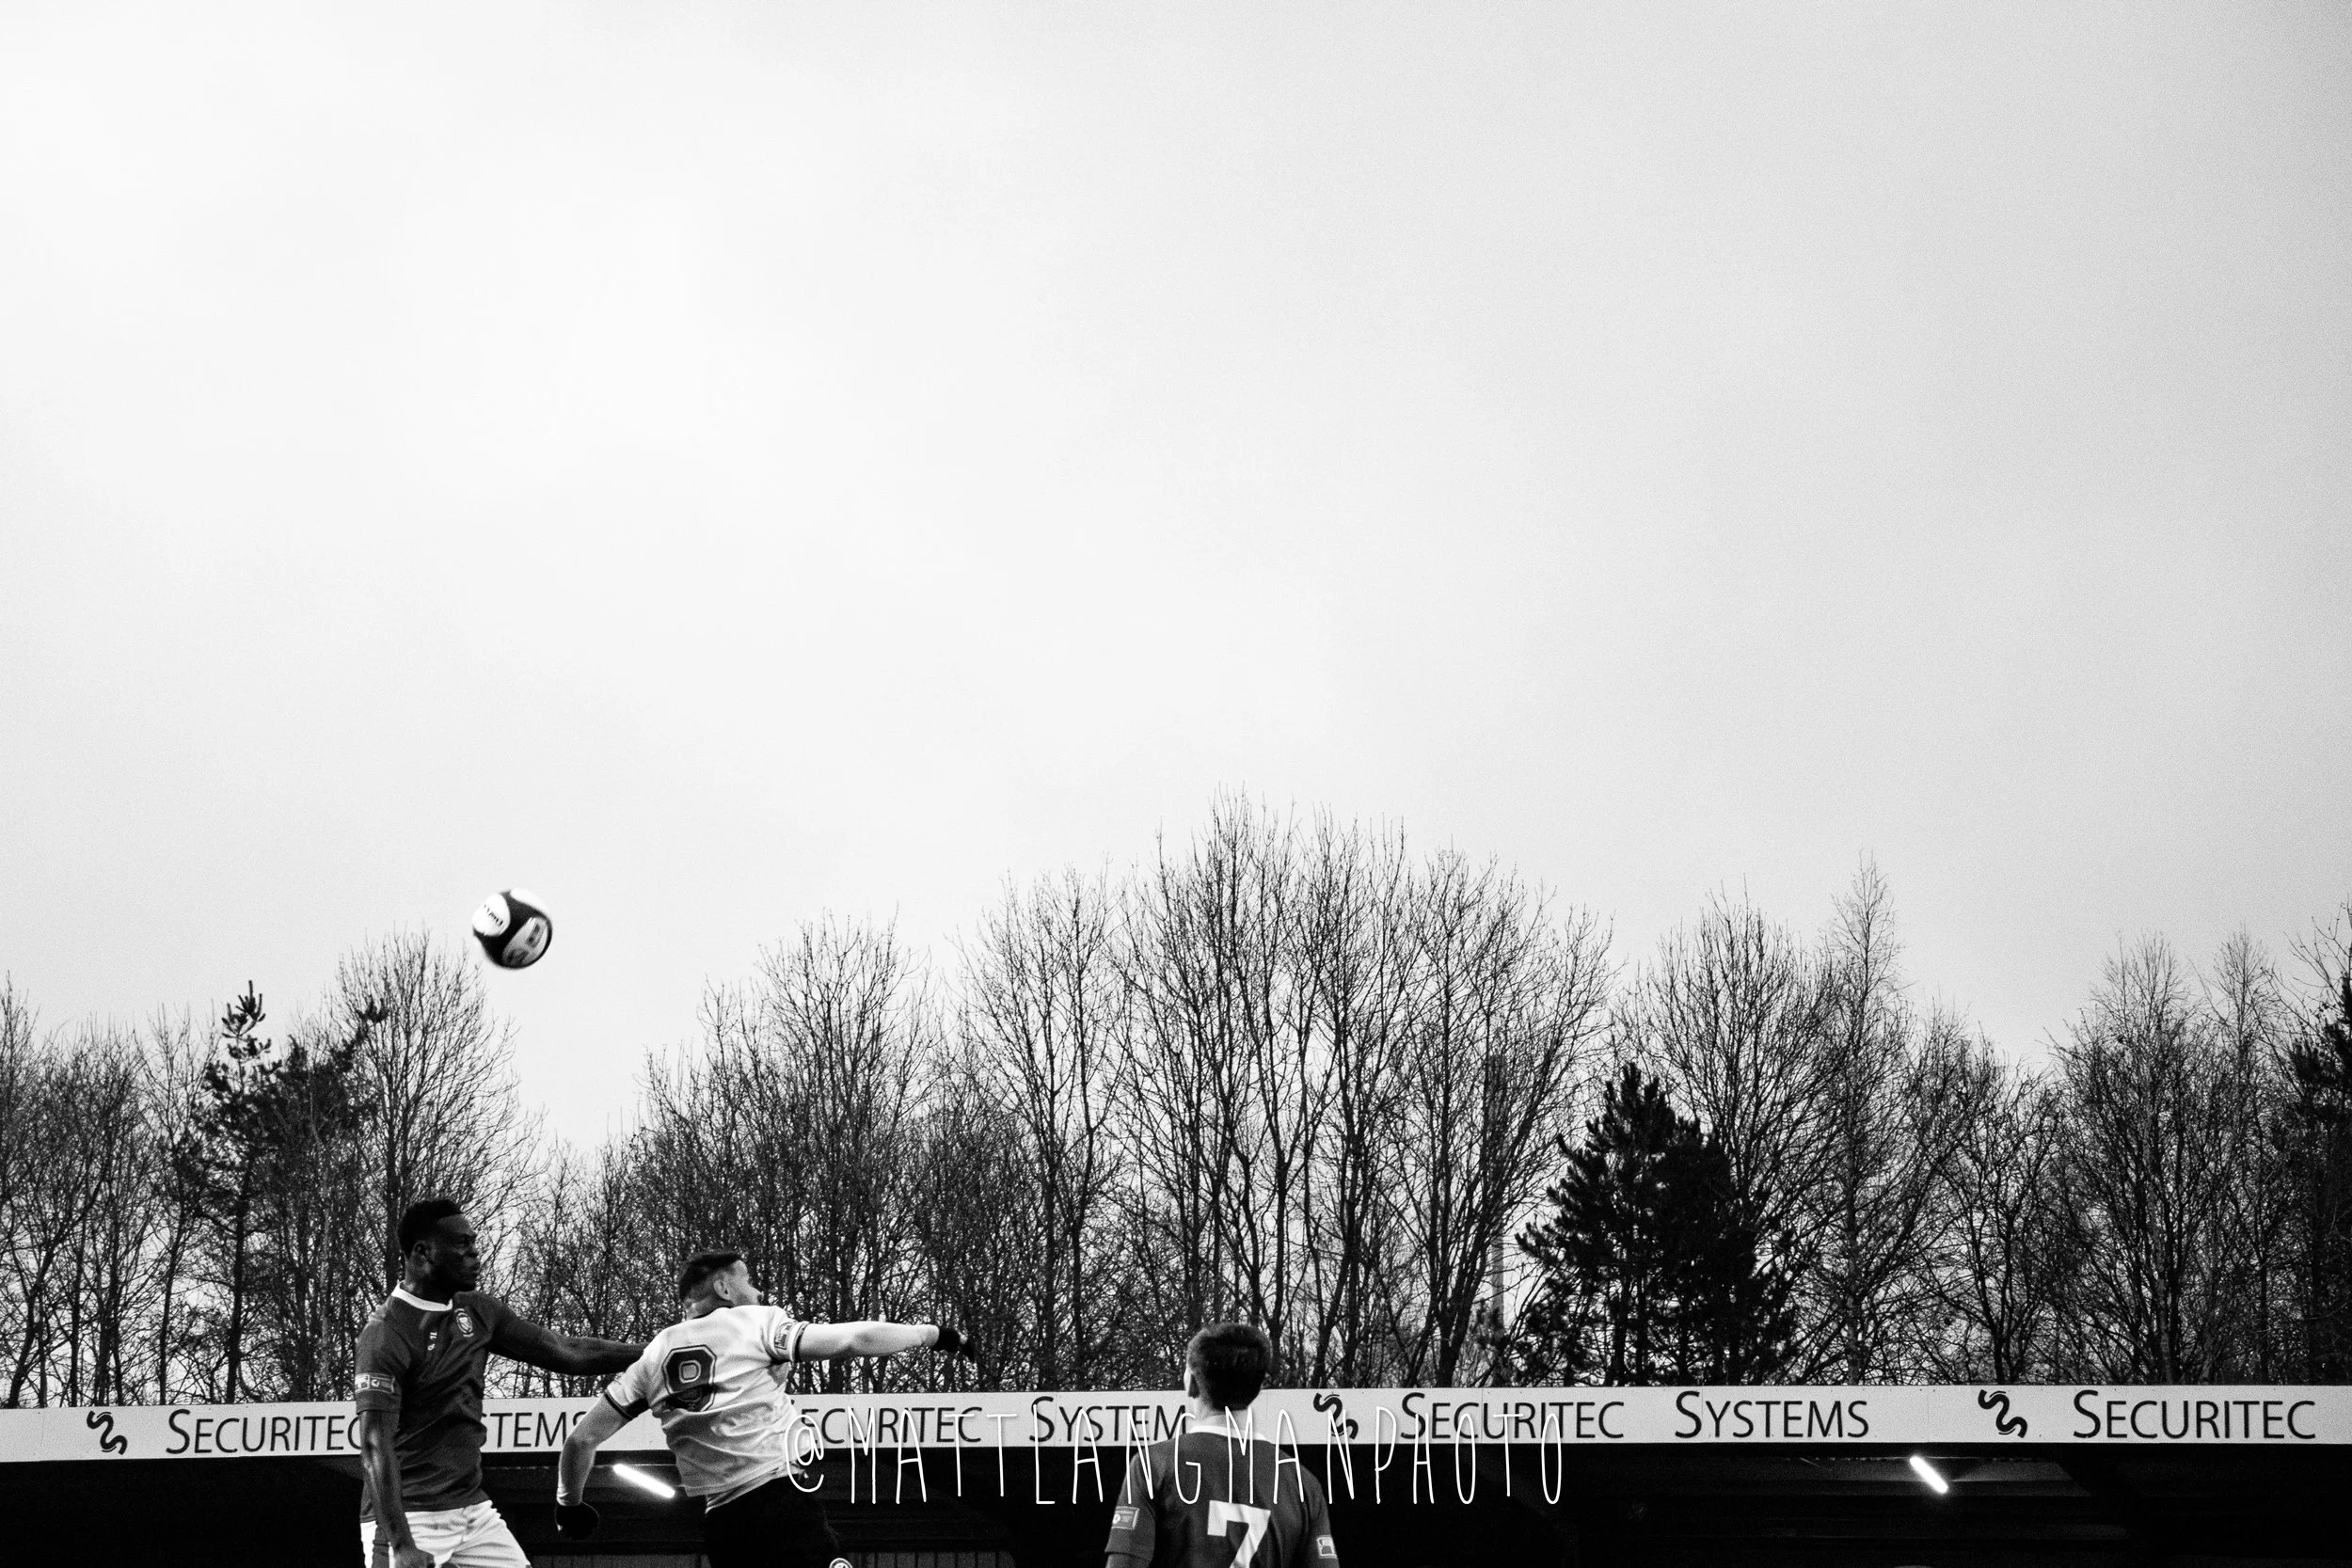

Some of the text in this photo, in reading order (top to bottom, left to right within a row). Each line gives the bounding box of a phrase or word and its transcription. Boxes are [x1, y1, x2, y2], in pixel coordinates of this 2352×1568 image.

[790, 1395, 1186, 1444] ECURITEC SYSTEM
[1400, 1389, 1869, 1439] SECURITEC SYSTEMS
[2073, 1389, 2316, 1439] SECURITEC
[1207, 1499, 1272, 1568] 7
